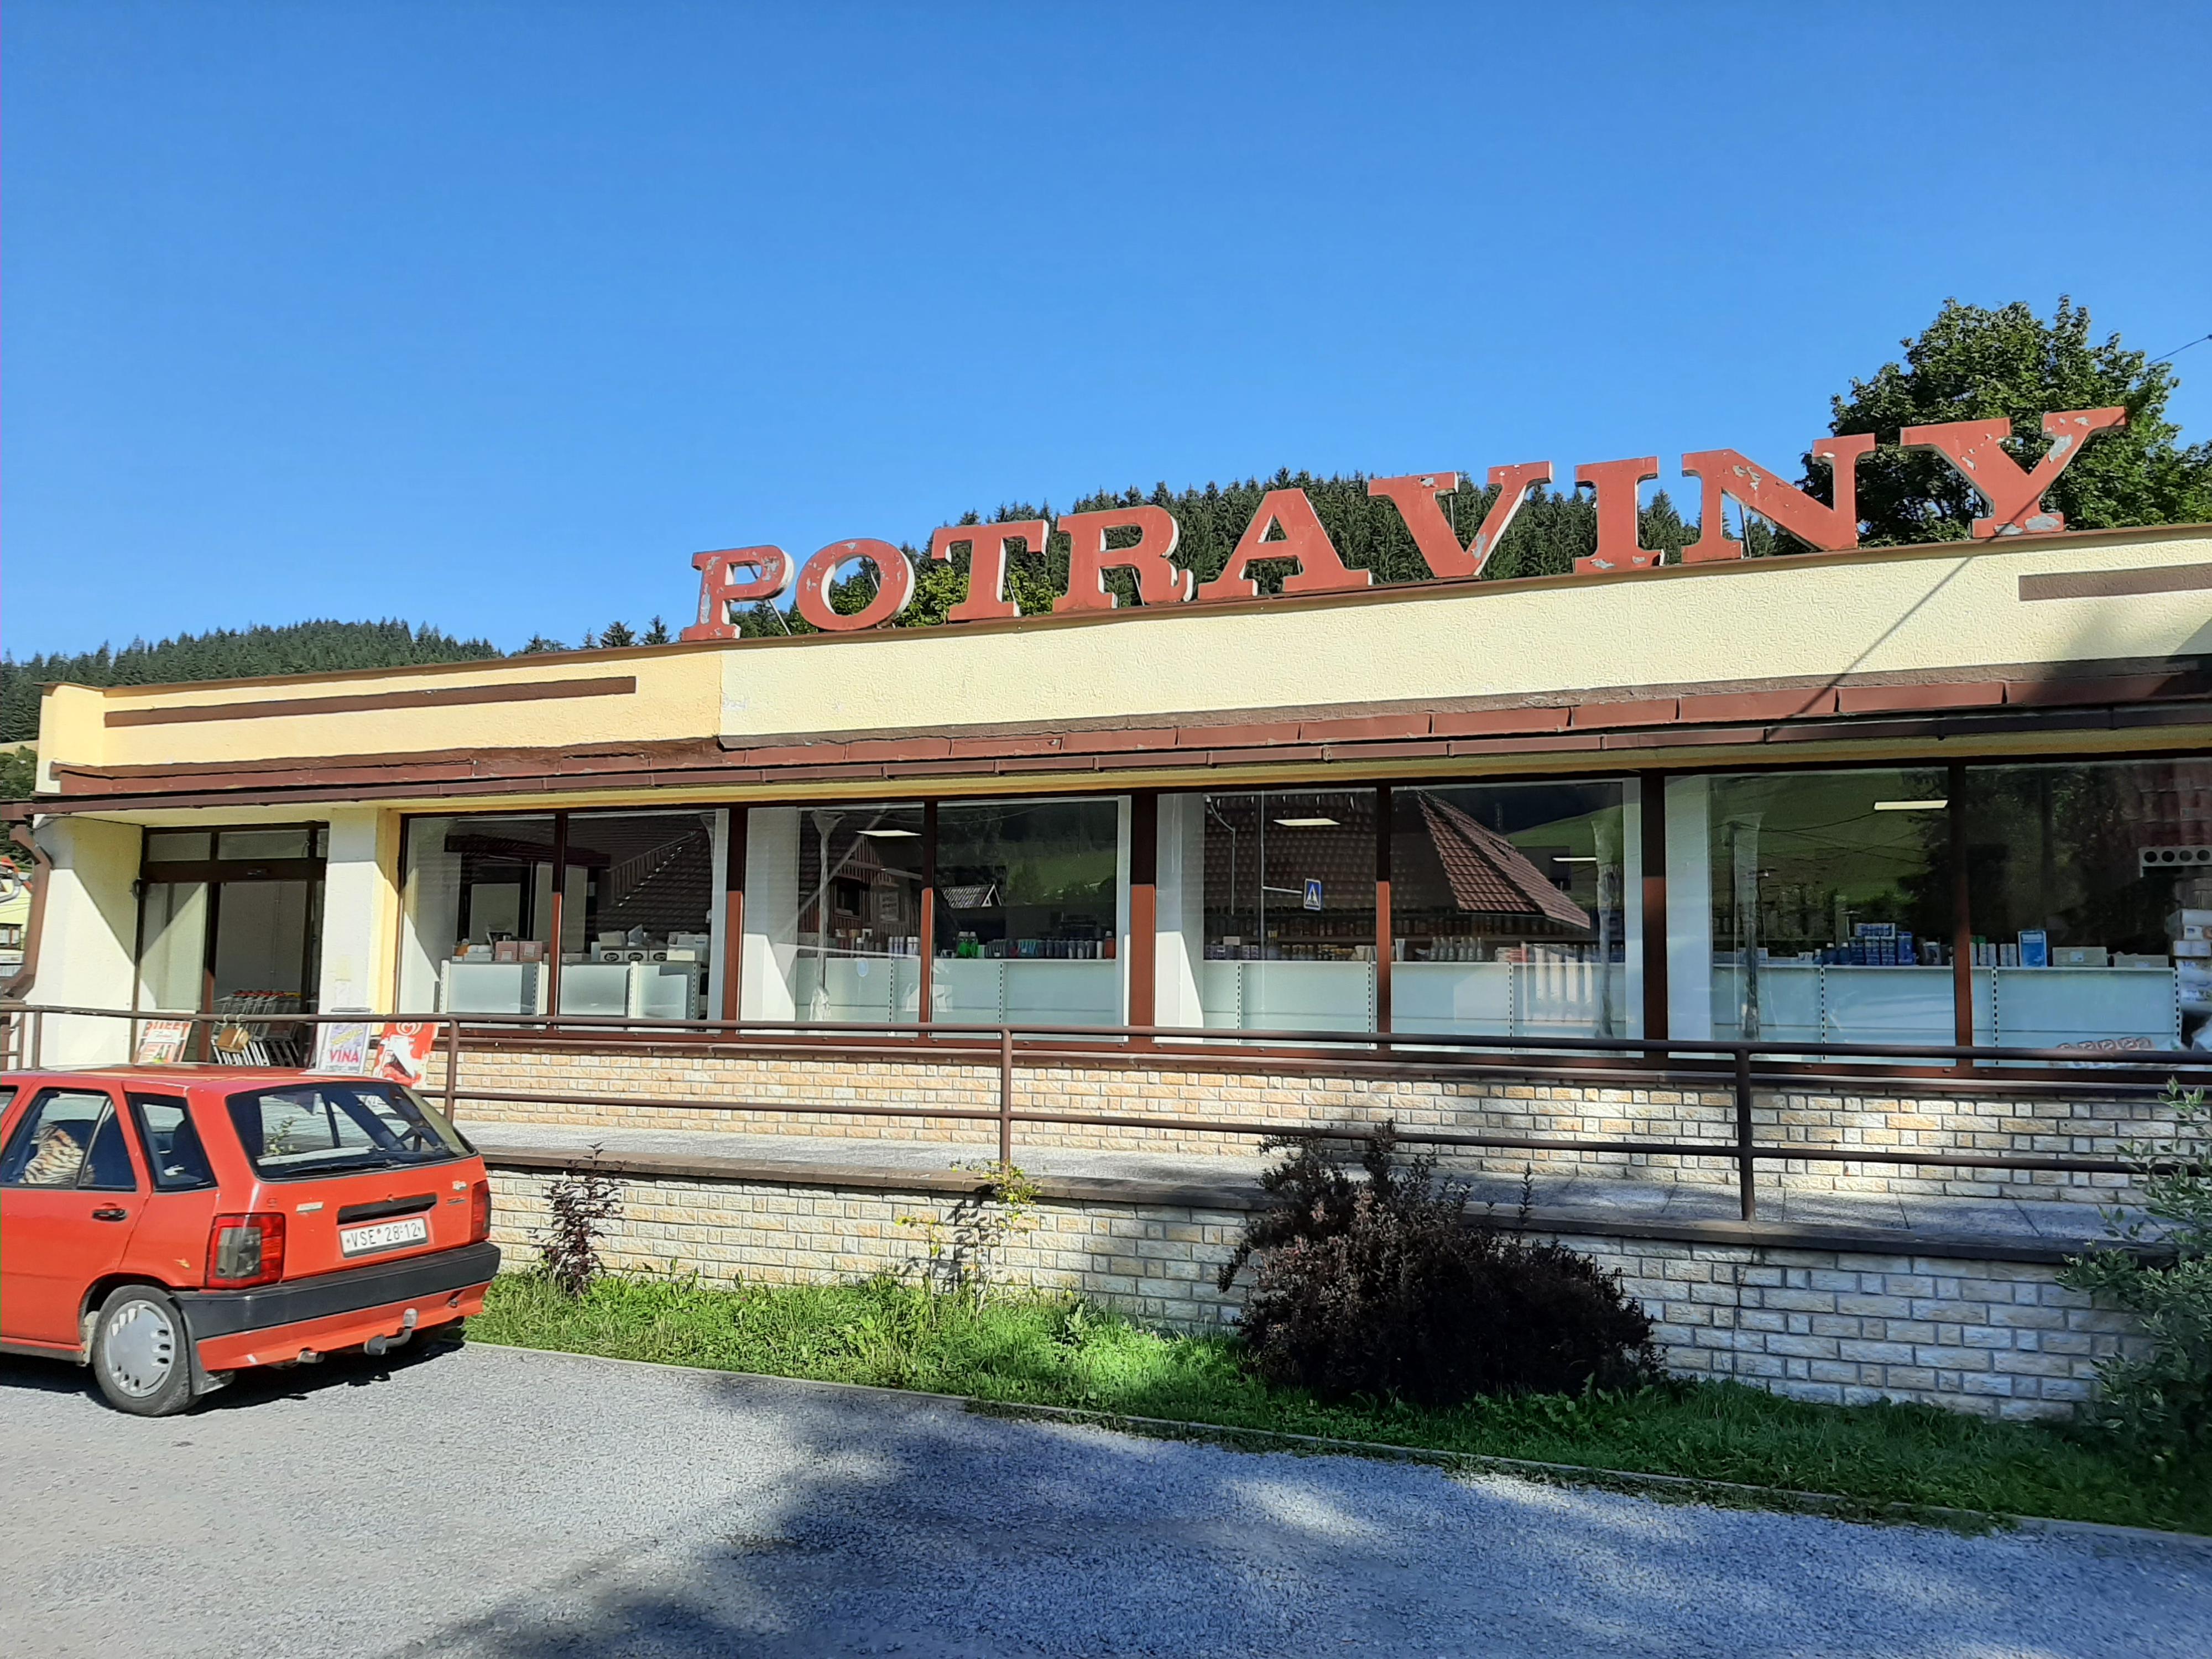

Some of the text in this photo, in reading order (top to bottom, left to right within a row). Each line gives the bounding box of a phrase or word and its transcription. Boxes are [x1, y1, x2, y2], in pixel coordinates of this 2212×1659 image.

[682, 405, 2126, 641] POTRAVINY
[351, 1223, 418, 1247] VSE 28-12
